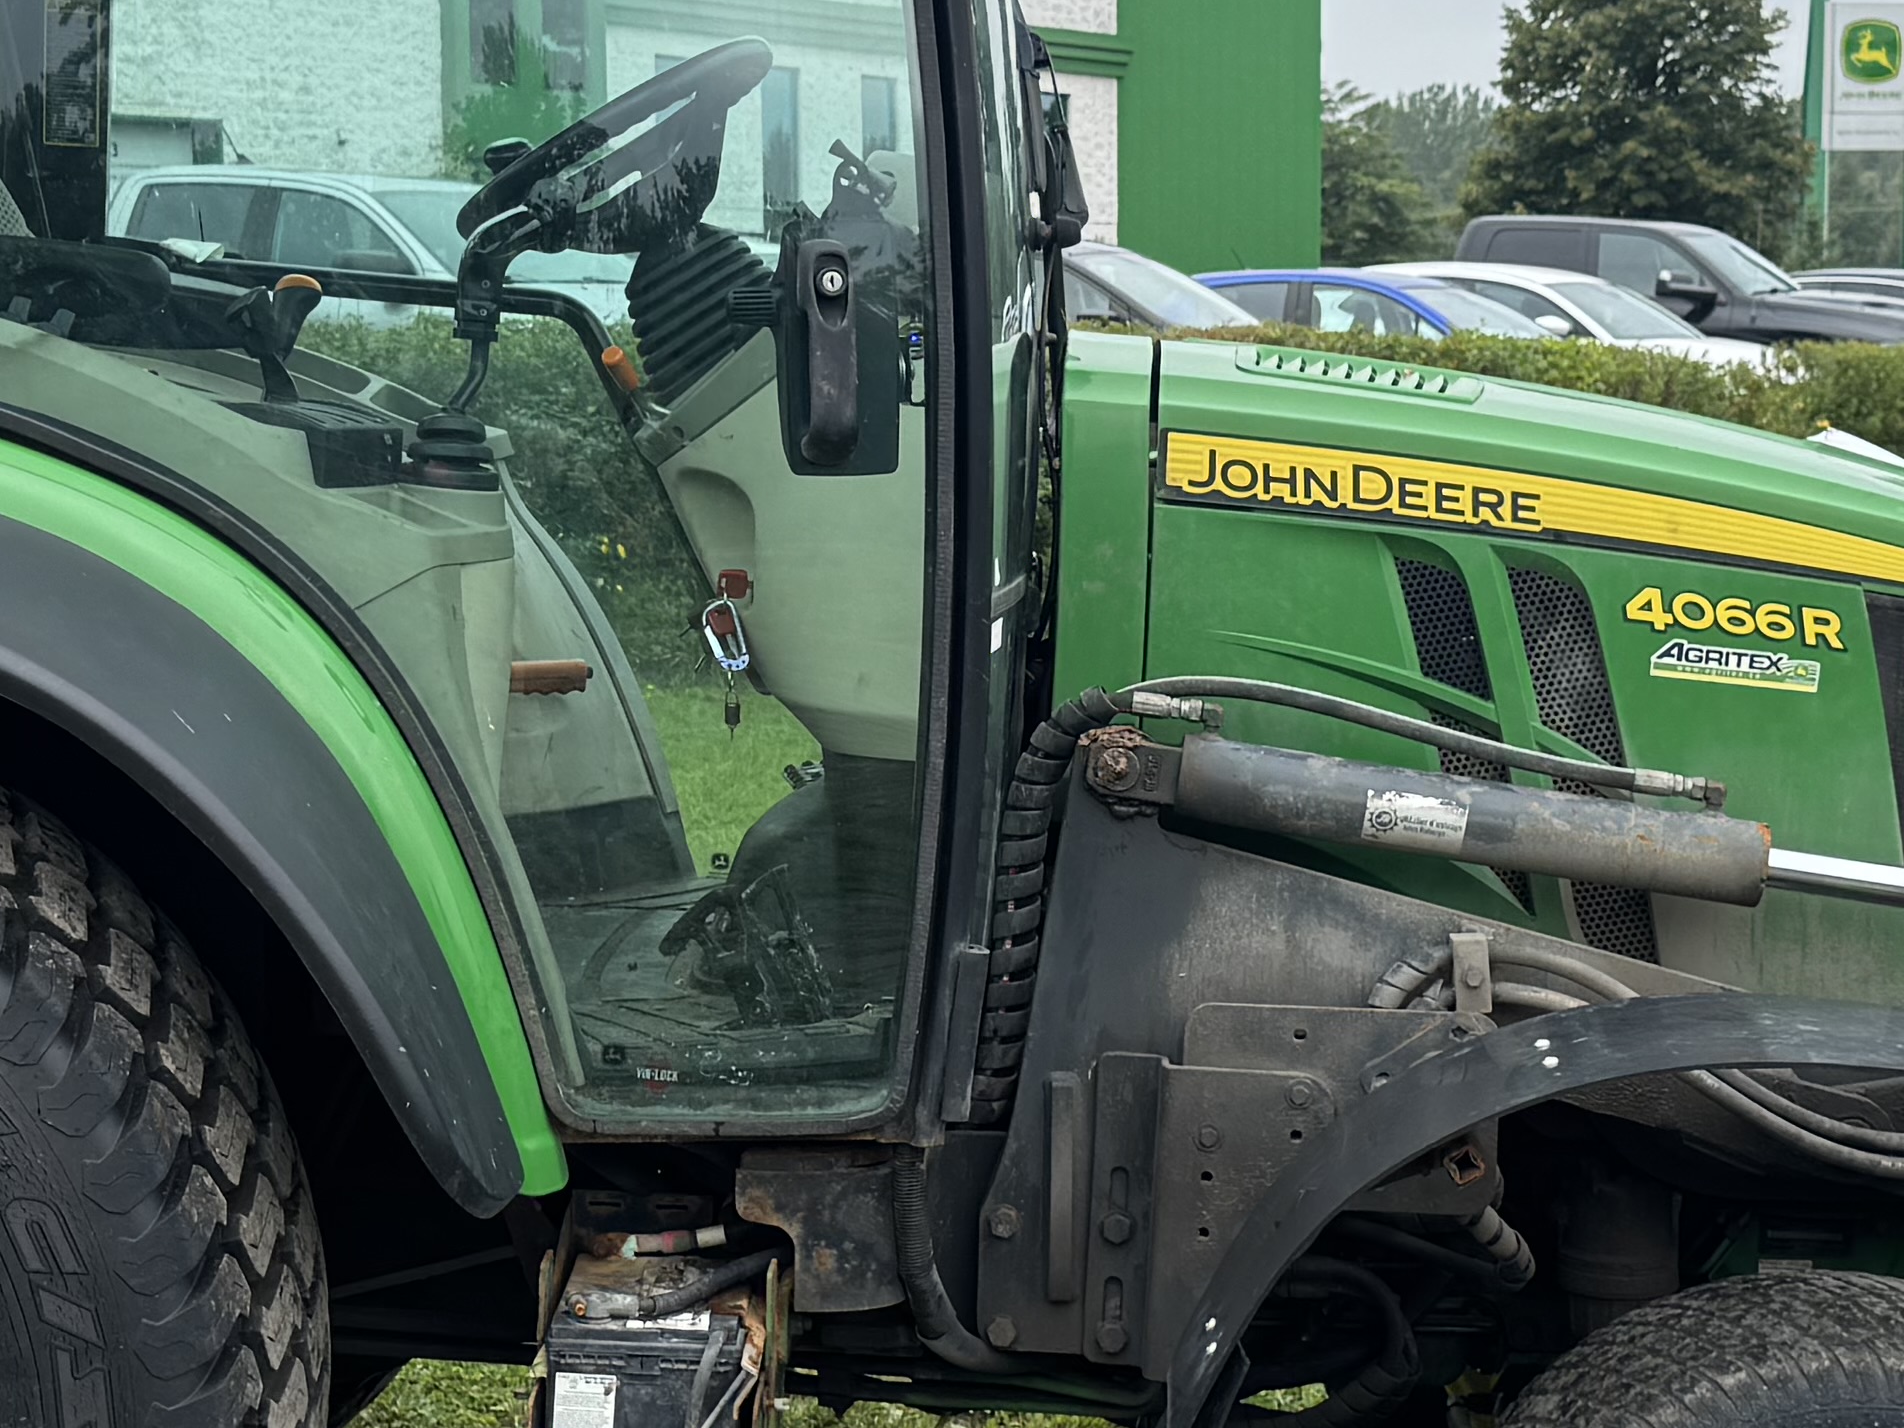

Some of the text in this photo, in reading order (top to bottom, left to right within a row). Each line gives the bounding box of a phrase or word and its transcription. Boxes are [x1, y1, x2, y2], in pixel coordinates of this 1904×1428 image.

[1188, 449, 1542, 526] JOHN DEERE
[1656, 641, 1785, 672] AGRITEX
